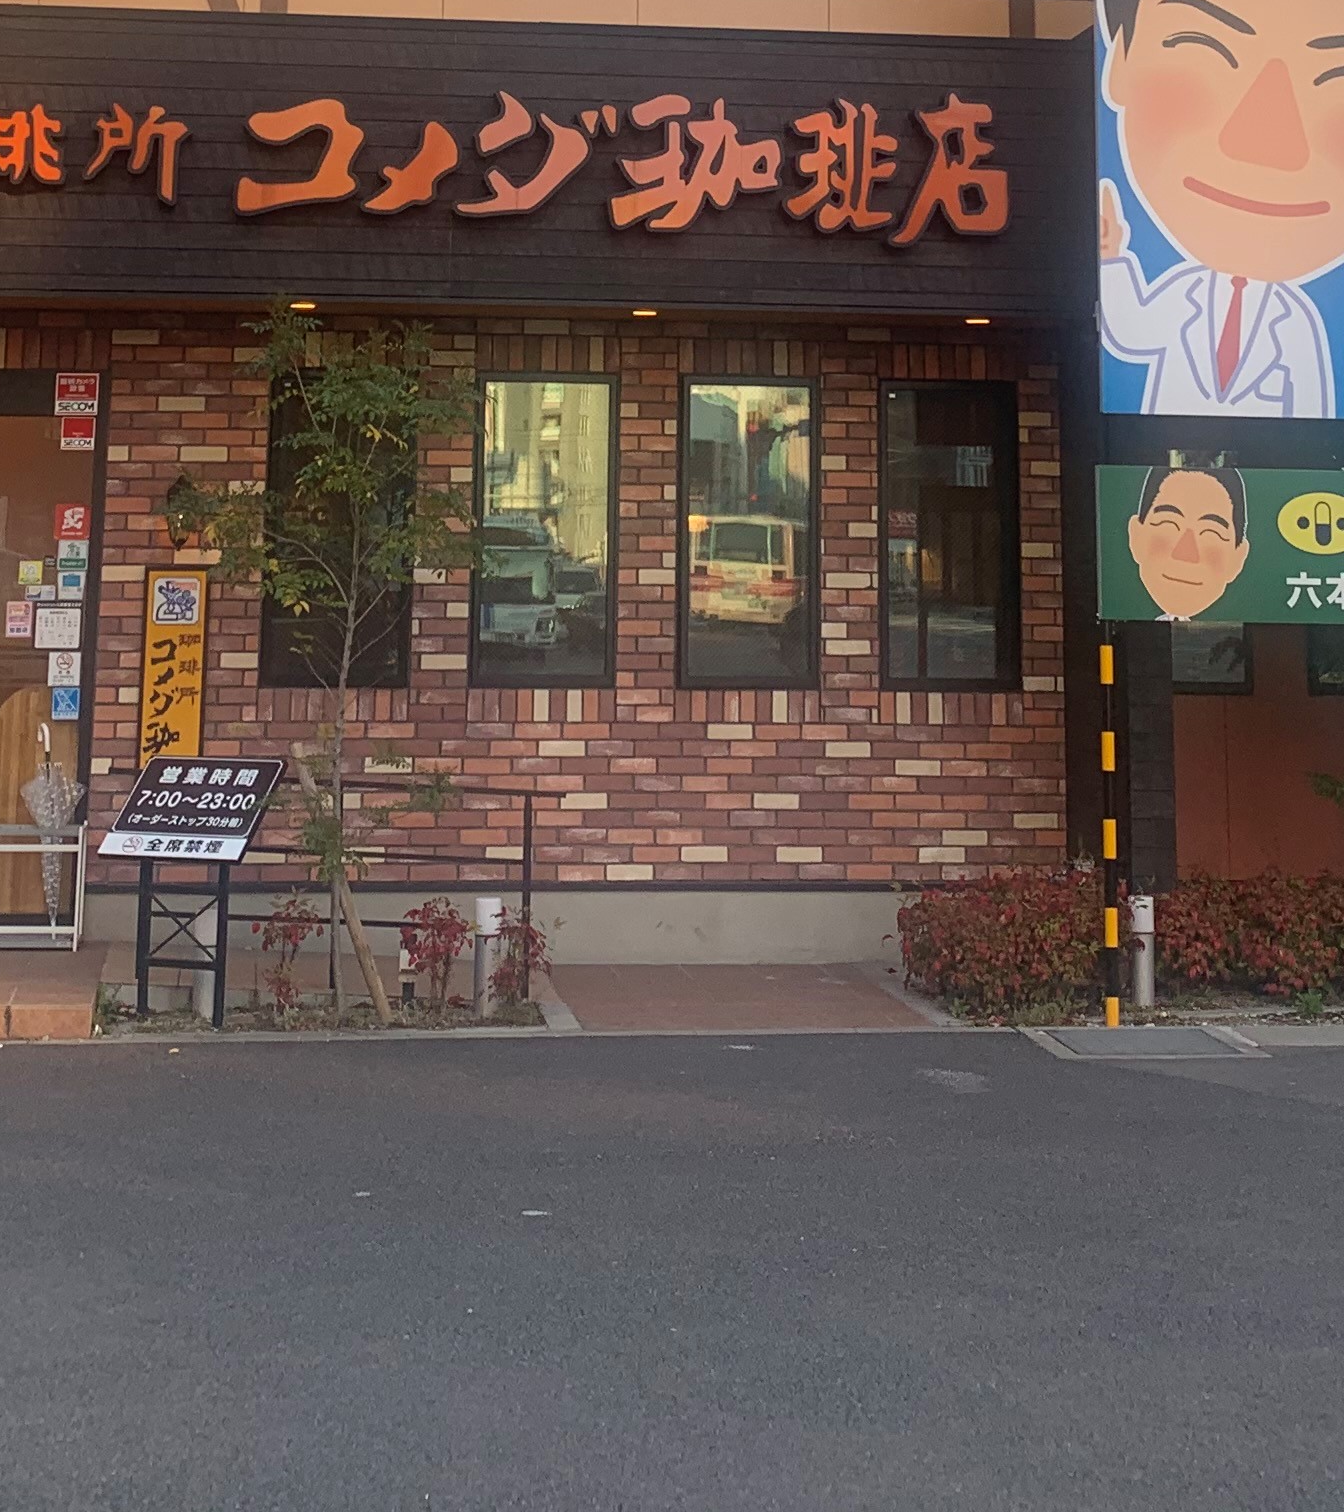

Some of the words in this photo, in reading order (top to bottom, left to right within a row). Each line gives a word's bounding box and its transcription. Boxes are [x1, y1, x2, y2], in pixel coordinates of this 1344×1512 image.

[143, 638, 180, 764] コメダ珈
[159, 765, 259, 787] 営業時間
[144, 838, 224, 854] 全席禁煙
